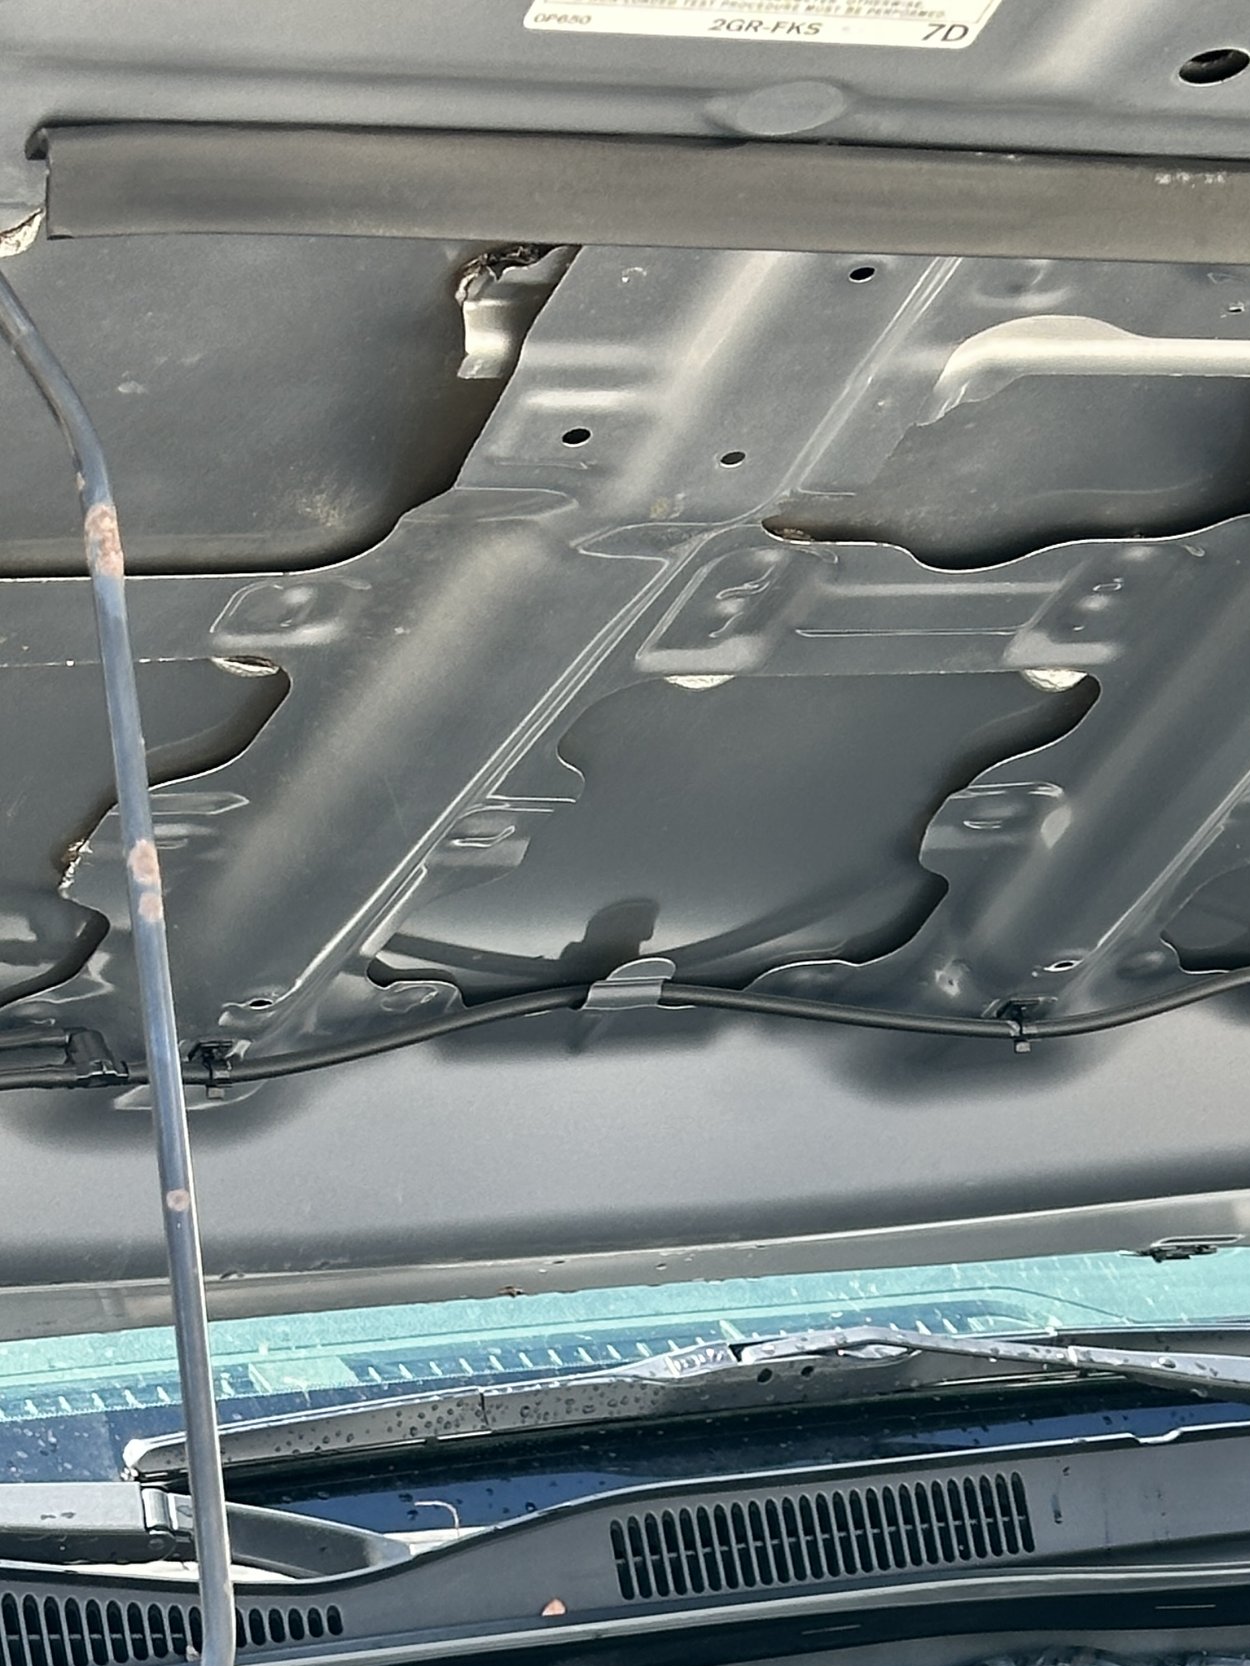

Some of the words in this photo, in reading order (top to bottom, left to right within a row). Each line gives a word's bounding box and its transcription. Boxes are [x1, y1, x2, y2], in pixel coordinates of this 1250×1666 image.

[804, 5, 841, 14] MUST
[844, 6, 863, 15] BE
[707, 18, 822, 36] 2GR-FKS
[921, 23, 970, 42] 7D
